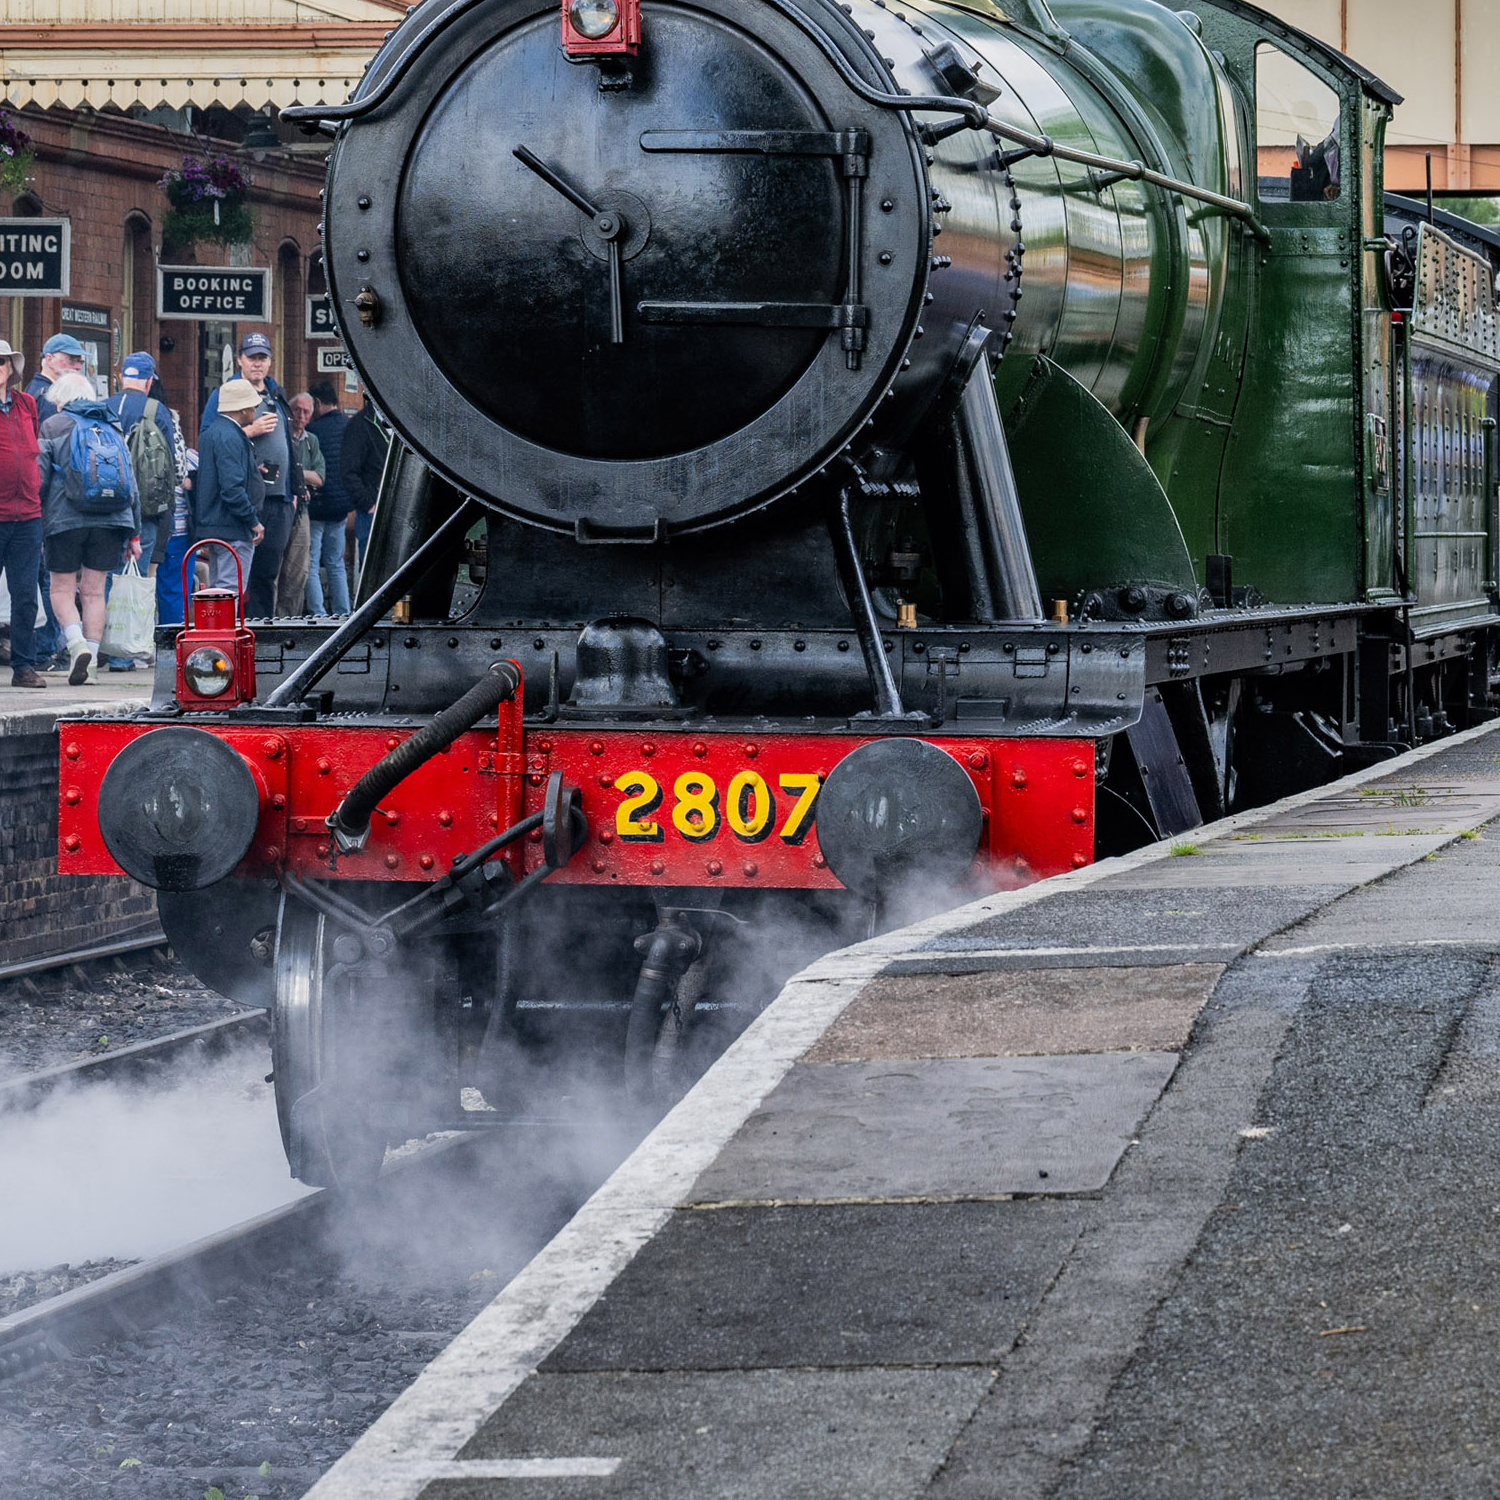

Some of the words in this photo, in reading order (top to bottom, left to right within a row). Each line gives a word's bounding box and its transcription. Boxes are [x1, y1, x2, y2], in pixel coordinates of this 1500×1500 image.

[173, 278, 253, 291] BOOKING
[180, 295, 245, 309] OFFICE
[325, 353, 348, 365] OPE
[614, 770, 822, 846] 2807
